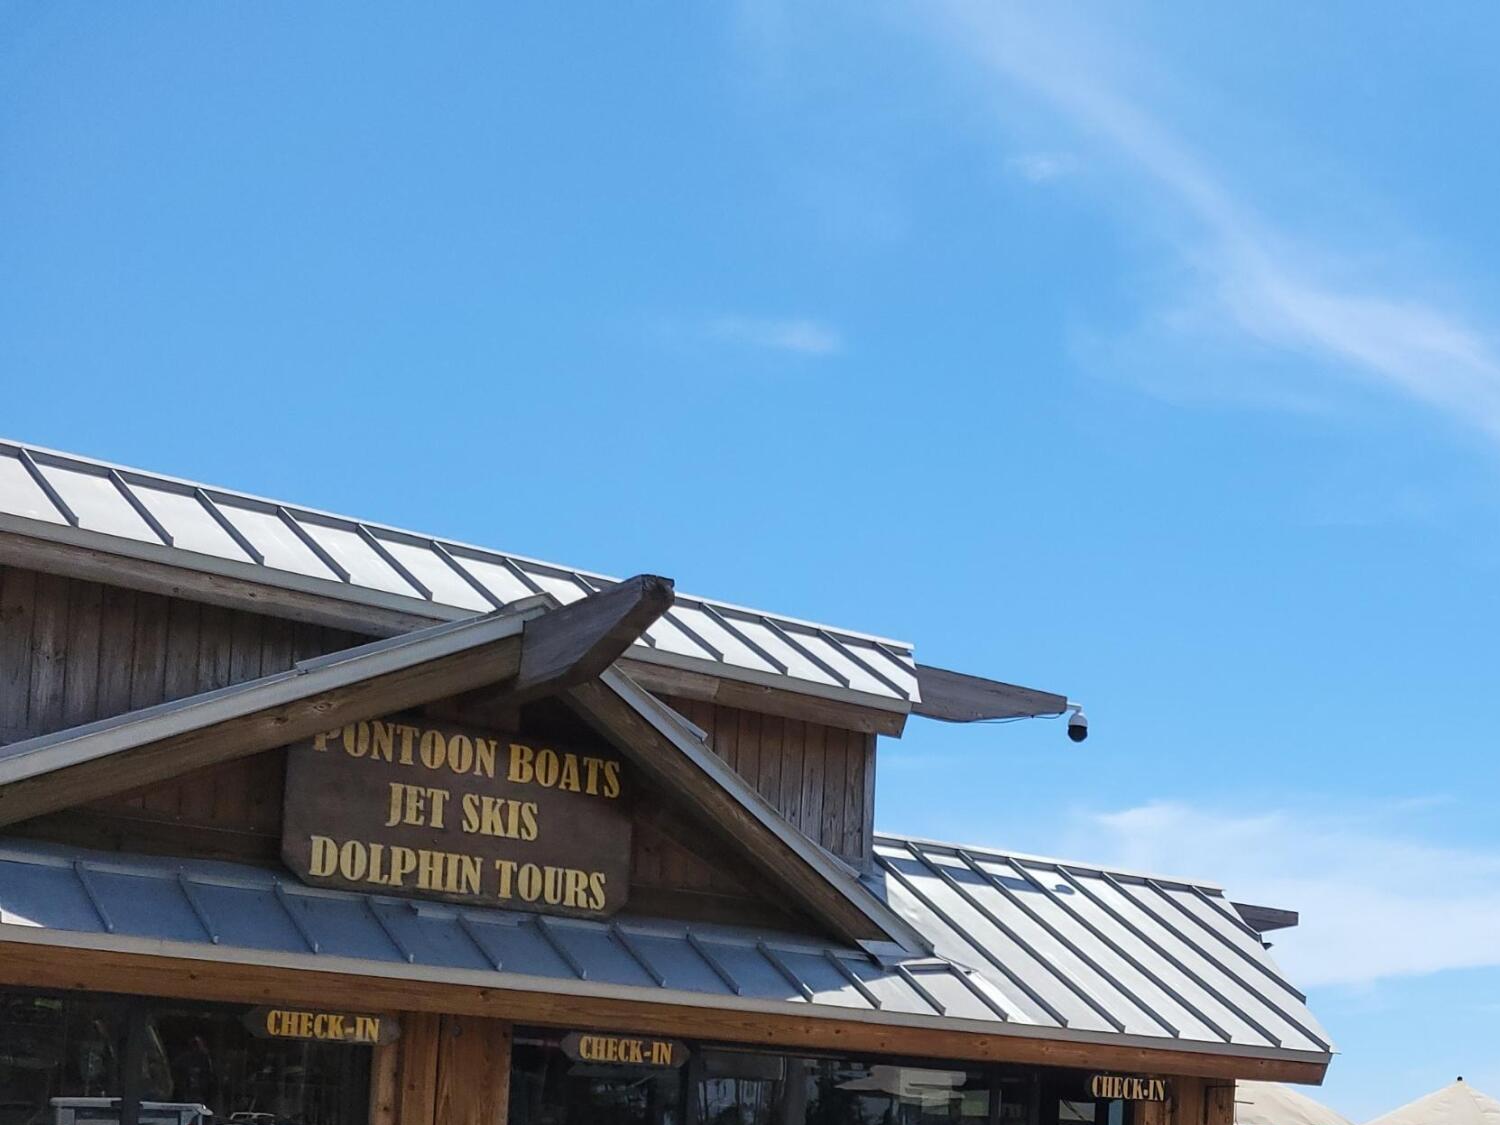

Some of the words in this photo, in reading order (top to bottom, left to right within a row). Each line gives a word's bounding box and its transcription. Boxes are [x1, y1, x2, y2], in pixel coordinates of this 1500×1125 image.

[313, 720, 497, 778] PONTOON
[507, 743, 621, 799] BOATS
[385, 782, 449, 828] JET
[462, 793, 539, 841] SKIS
[308, 835, 483, 895] DOLPHIN
[495, 859, 607, 911] TOURS
[267, 1010, 379, 1043] CHECK-IN
[580, 1036, 672, 1065] CHECK-IN
[1092, 1075, 1165, 1101] CHECK-IN
